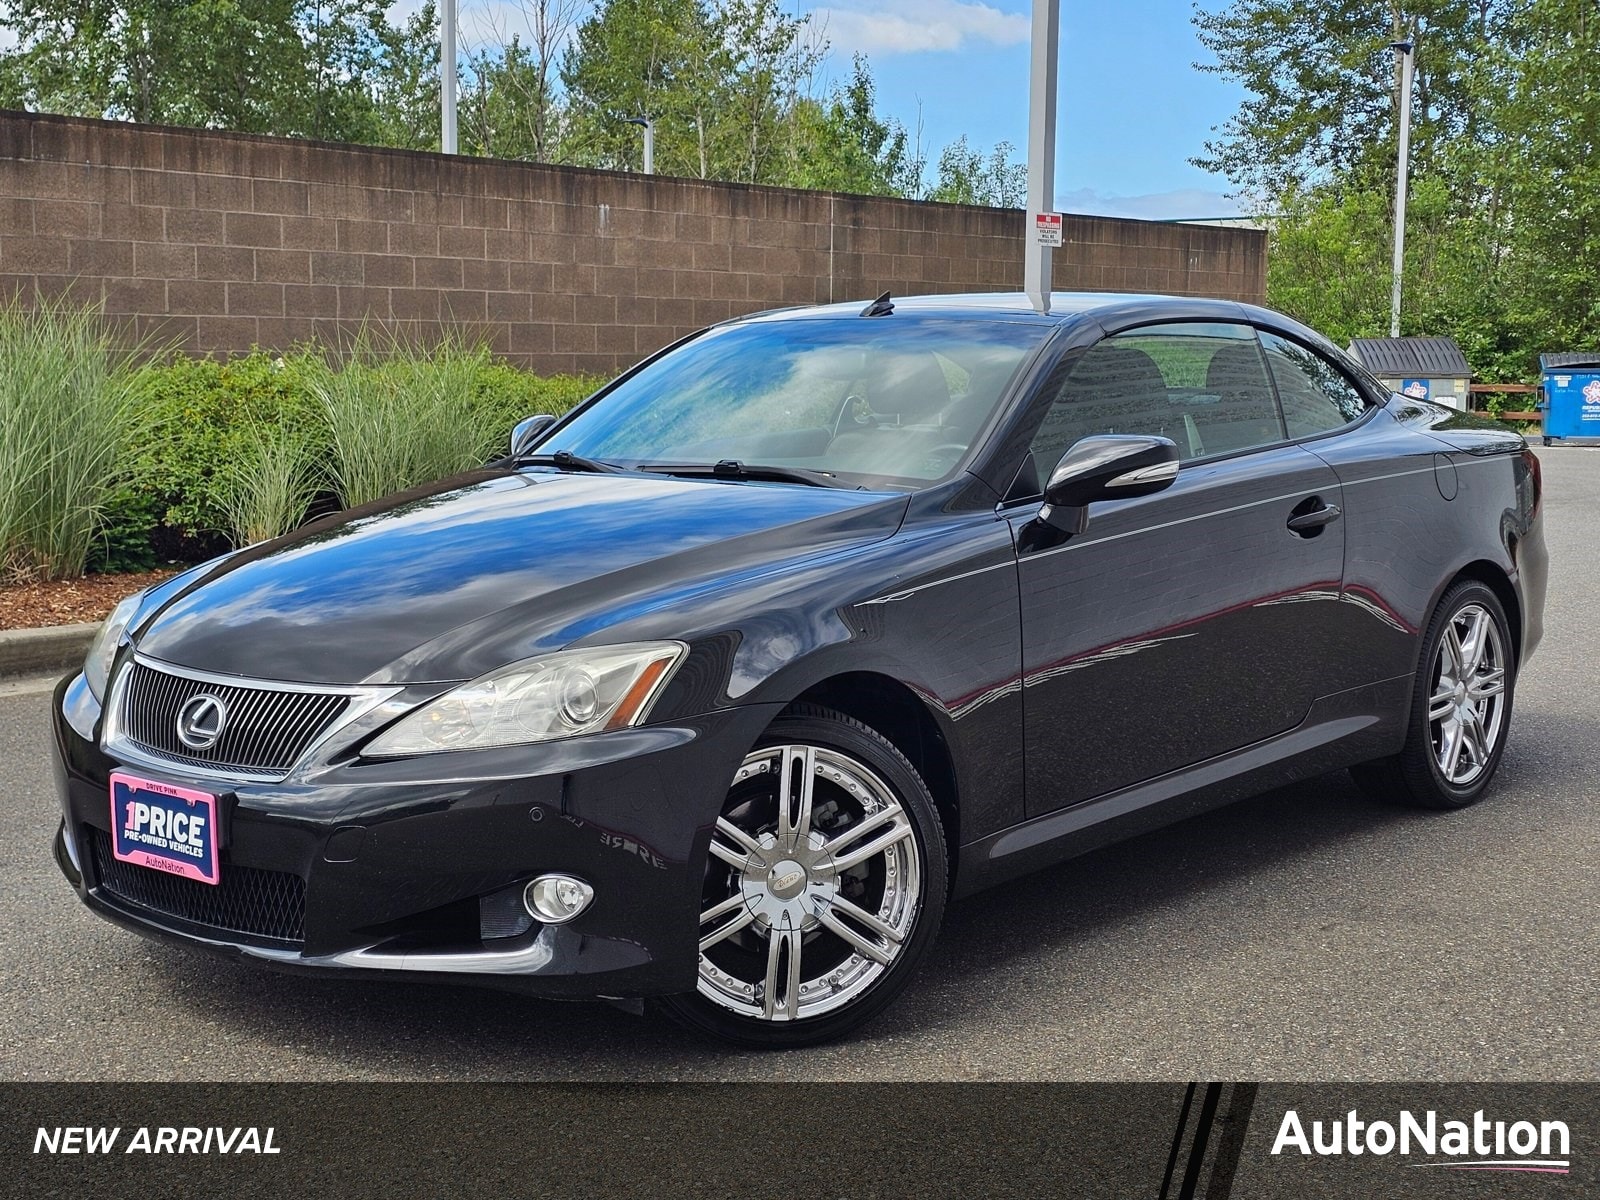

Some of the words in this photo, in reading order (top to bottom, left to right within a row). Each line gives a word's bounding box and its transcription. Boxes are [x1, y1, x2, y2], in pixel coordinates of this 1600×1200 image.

[146, 783, 163, 793] DRIVE
[164, 786, 178, 795] PINK
[124, 829, 168, 848] PRE-OWNED
[168, 840, 203, 858] VEHICLES
[145, 856, 185, 875] AutoNation
